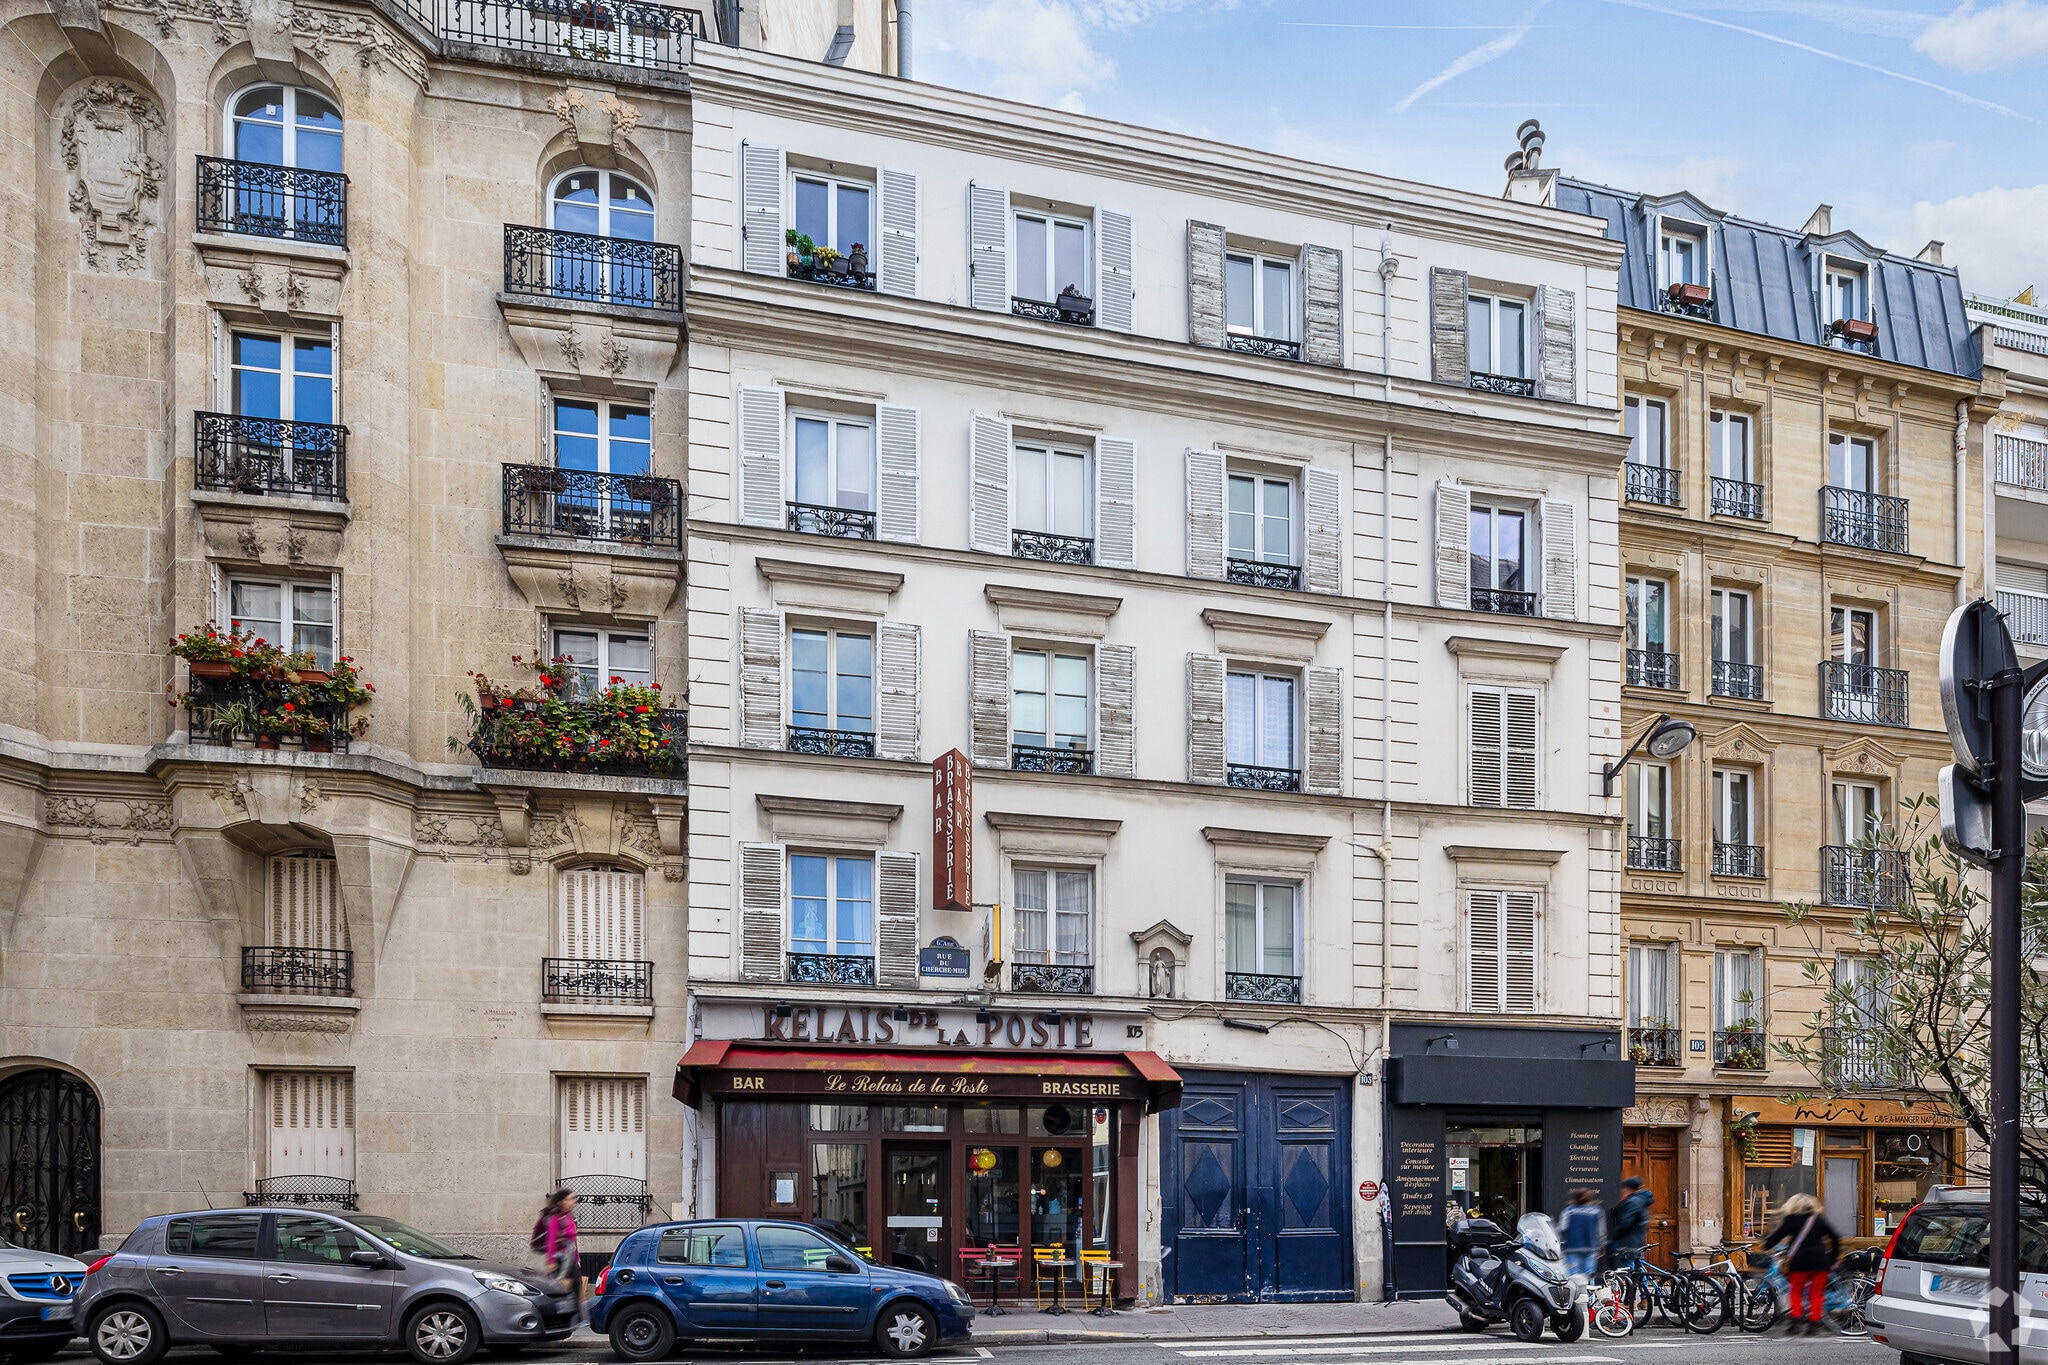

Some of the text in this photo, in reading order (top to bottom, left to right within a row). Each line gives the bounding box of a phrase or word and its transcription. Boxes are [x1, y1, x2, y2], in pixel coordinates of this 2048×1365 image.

[935, 769, 943, 834] BAR
[946, 754, 954, 900] BRASSERIE
[921, 966, 968, 974] CHERCHE-MIDI
[762, 1007, 1093, 1048] RELAIS DE LA POSTE
[1691, 1041, 1704, 1050] 105
[733, 1077, 765, 1090] BAR
[824, 1074, 989, 1094] Le Relais de la Poste
[1361, 1076, 1372, 1084] 103
[1042, 1082, 1120, 1096] BRASSERIE
[1874, 1115, 1888, 1123] CAVE
[1895, 1115, 1920, 1123] MANGER
[1569, 1143, 1599, 1151] Chauffage
